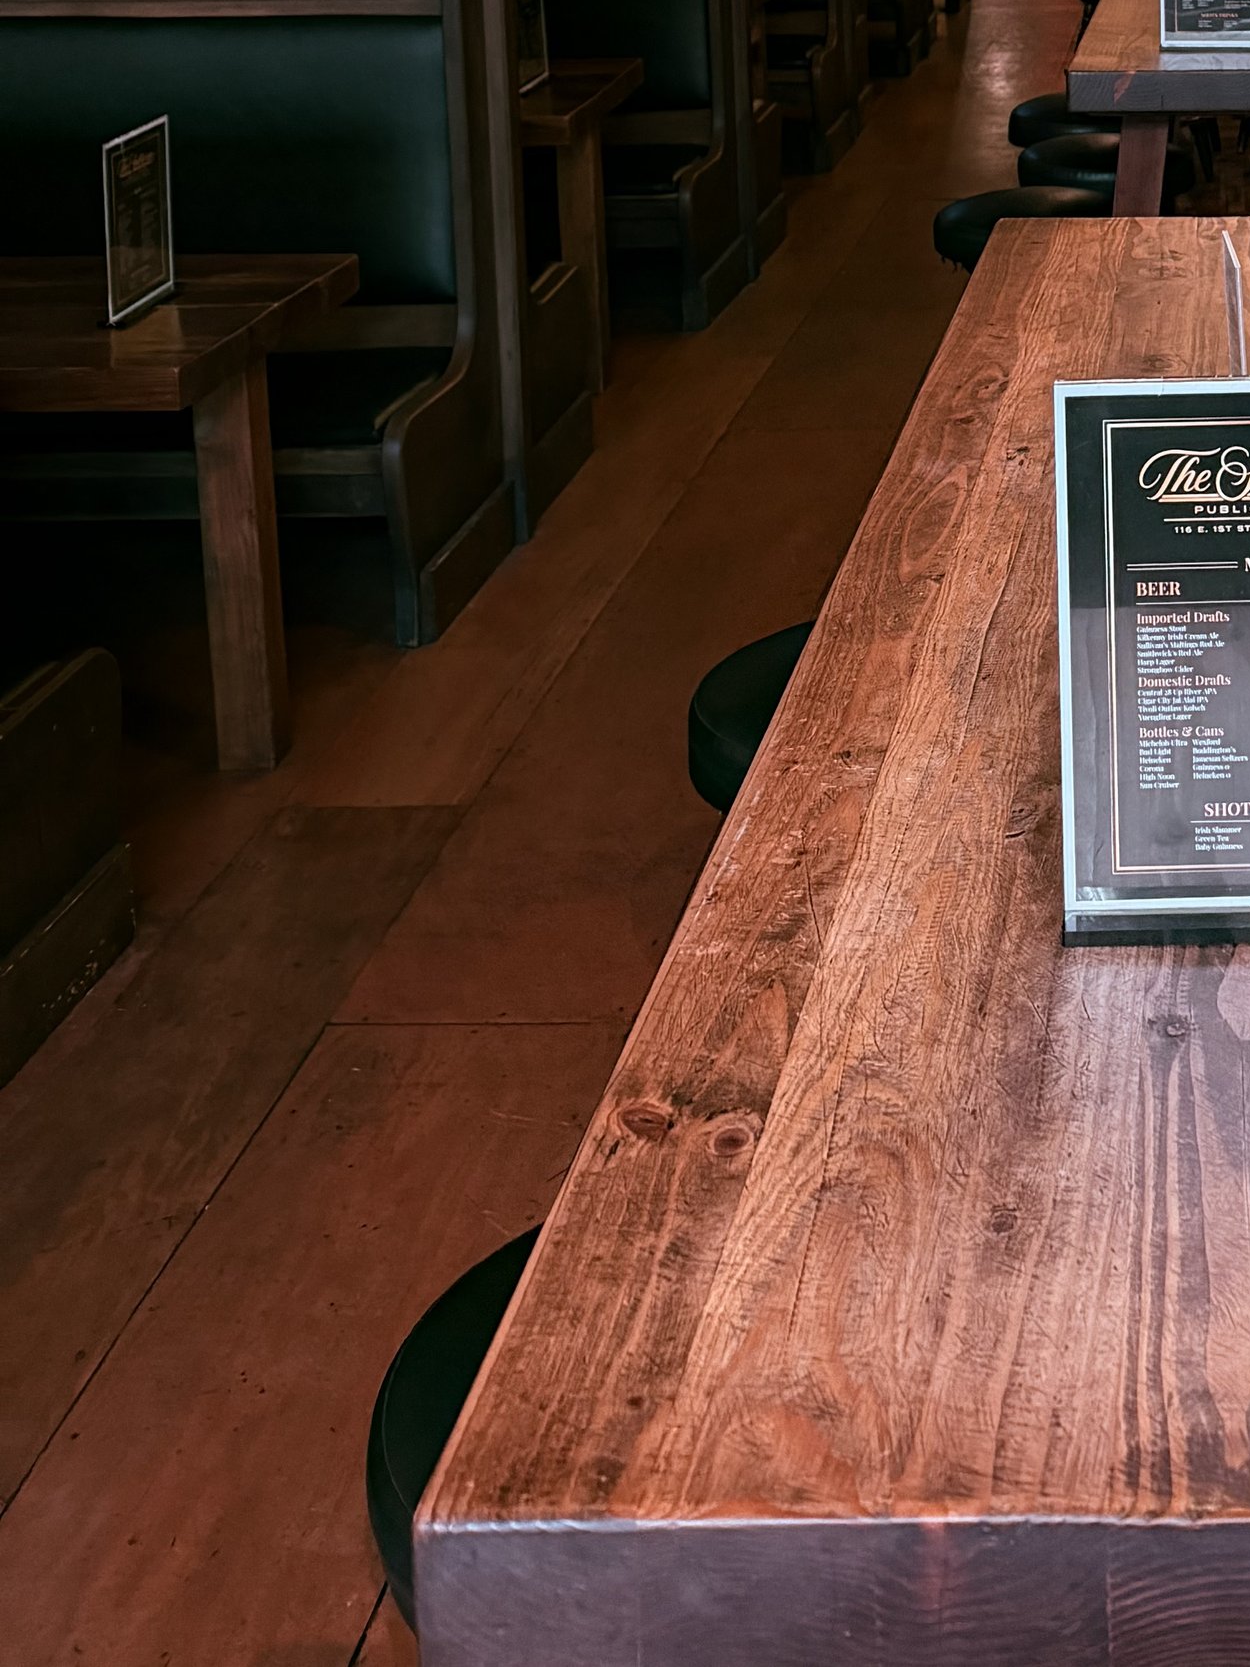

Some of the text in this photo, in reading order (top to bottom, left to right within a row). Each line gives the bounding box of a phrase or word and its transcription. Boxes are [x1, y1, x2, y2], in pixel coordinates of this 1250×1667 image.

[1139, 447, 1220, 501] The
[1174, 526, 1192, 534] 116
[1198, 525, 1208, 533] E.
[1213, 524, 1231, 533] 1ST
[1136, 581, 1180, 597] BEER
[1137, 610, 1230, 626] Imported Drafts
[1139, 674, 1231, 688] Domestic Drafts
[1140, 726, 1224, 739] Bottles & Cans
